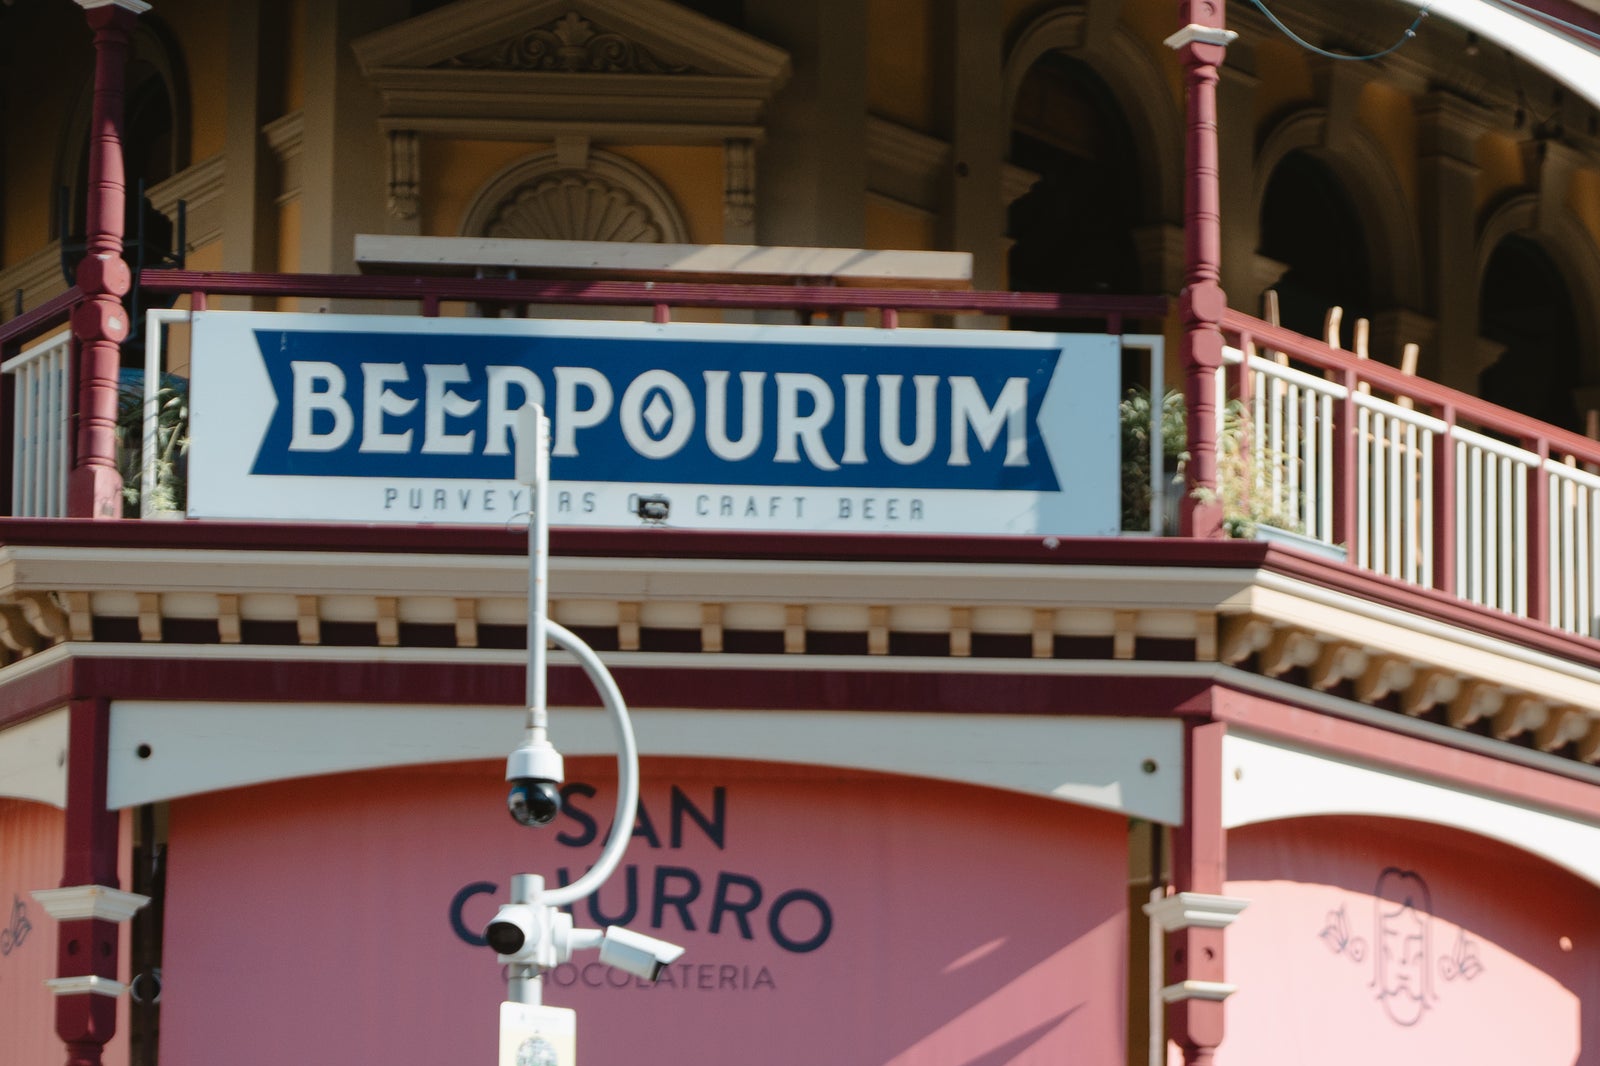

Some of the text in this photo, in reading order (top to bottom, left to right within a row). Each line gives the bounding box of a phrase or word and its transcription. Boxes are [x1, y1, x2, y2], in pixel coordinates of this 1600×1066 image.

[288, 360, 1031, 471] BEERPOURIUM
[384, 487, 596, 513] PURVEYRS
[696, 494, 807, 519] CRAFT
[837, 498, 924, 520] BEER
[555, 782, 727, 850] SAN
